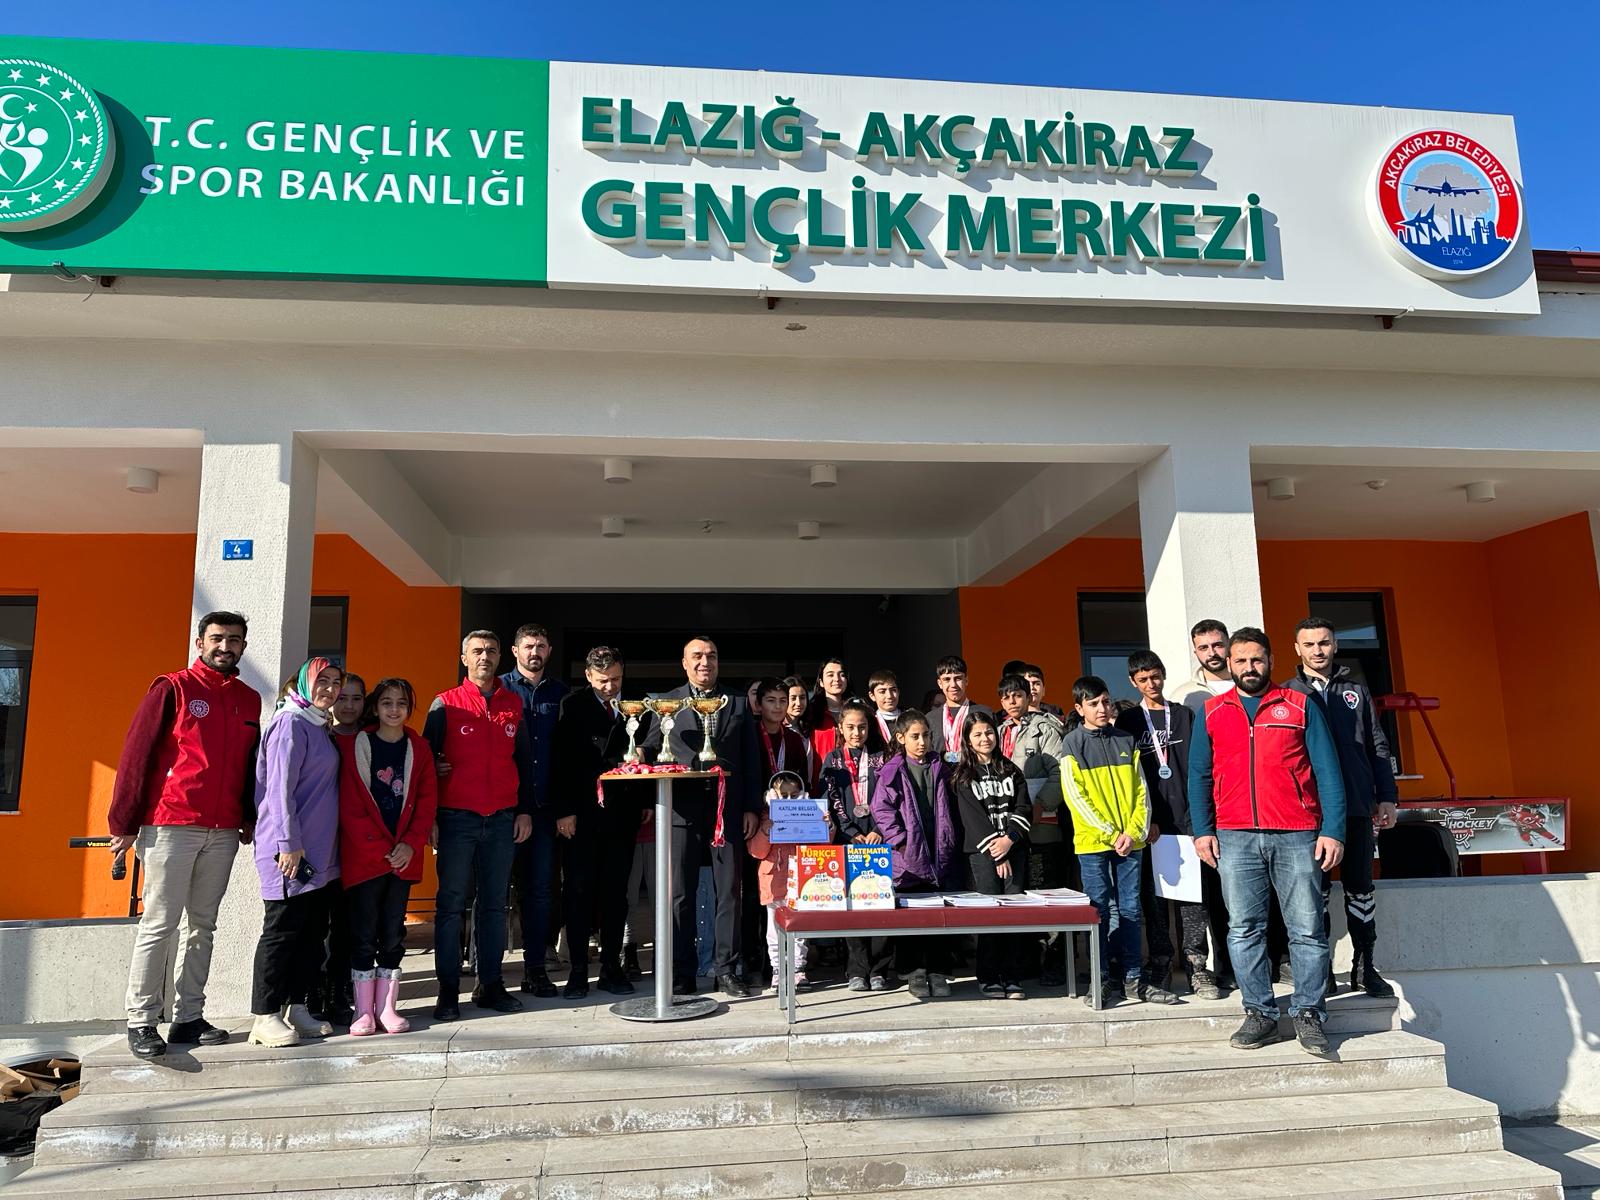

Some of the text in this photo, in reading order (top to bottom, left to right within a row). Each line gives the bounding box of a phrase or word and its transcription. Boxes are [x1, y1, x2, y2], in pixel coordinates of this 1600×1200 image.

[144, 116, 525, 164] T.C. GENÇLİK VE
[581, 96, 803, 154] ELAZIĞ
[855, 110, 1199, 173] AKÇAKİRAZ
[140, 163, 525, 207] SPOR BAKANLIĞI
[1445, 134, 1512, 197] BELEDİYESİ
[581, 175, 1267, 264] GENÇLİK MERKEZİ
[233, 544, 241, 554] 4
[1448, 820, 1494, 829] HOCKEY
[801, 848, 836, 860] TÜRKÇE
[847, 847, 889, 855] MATEMATİK
